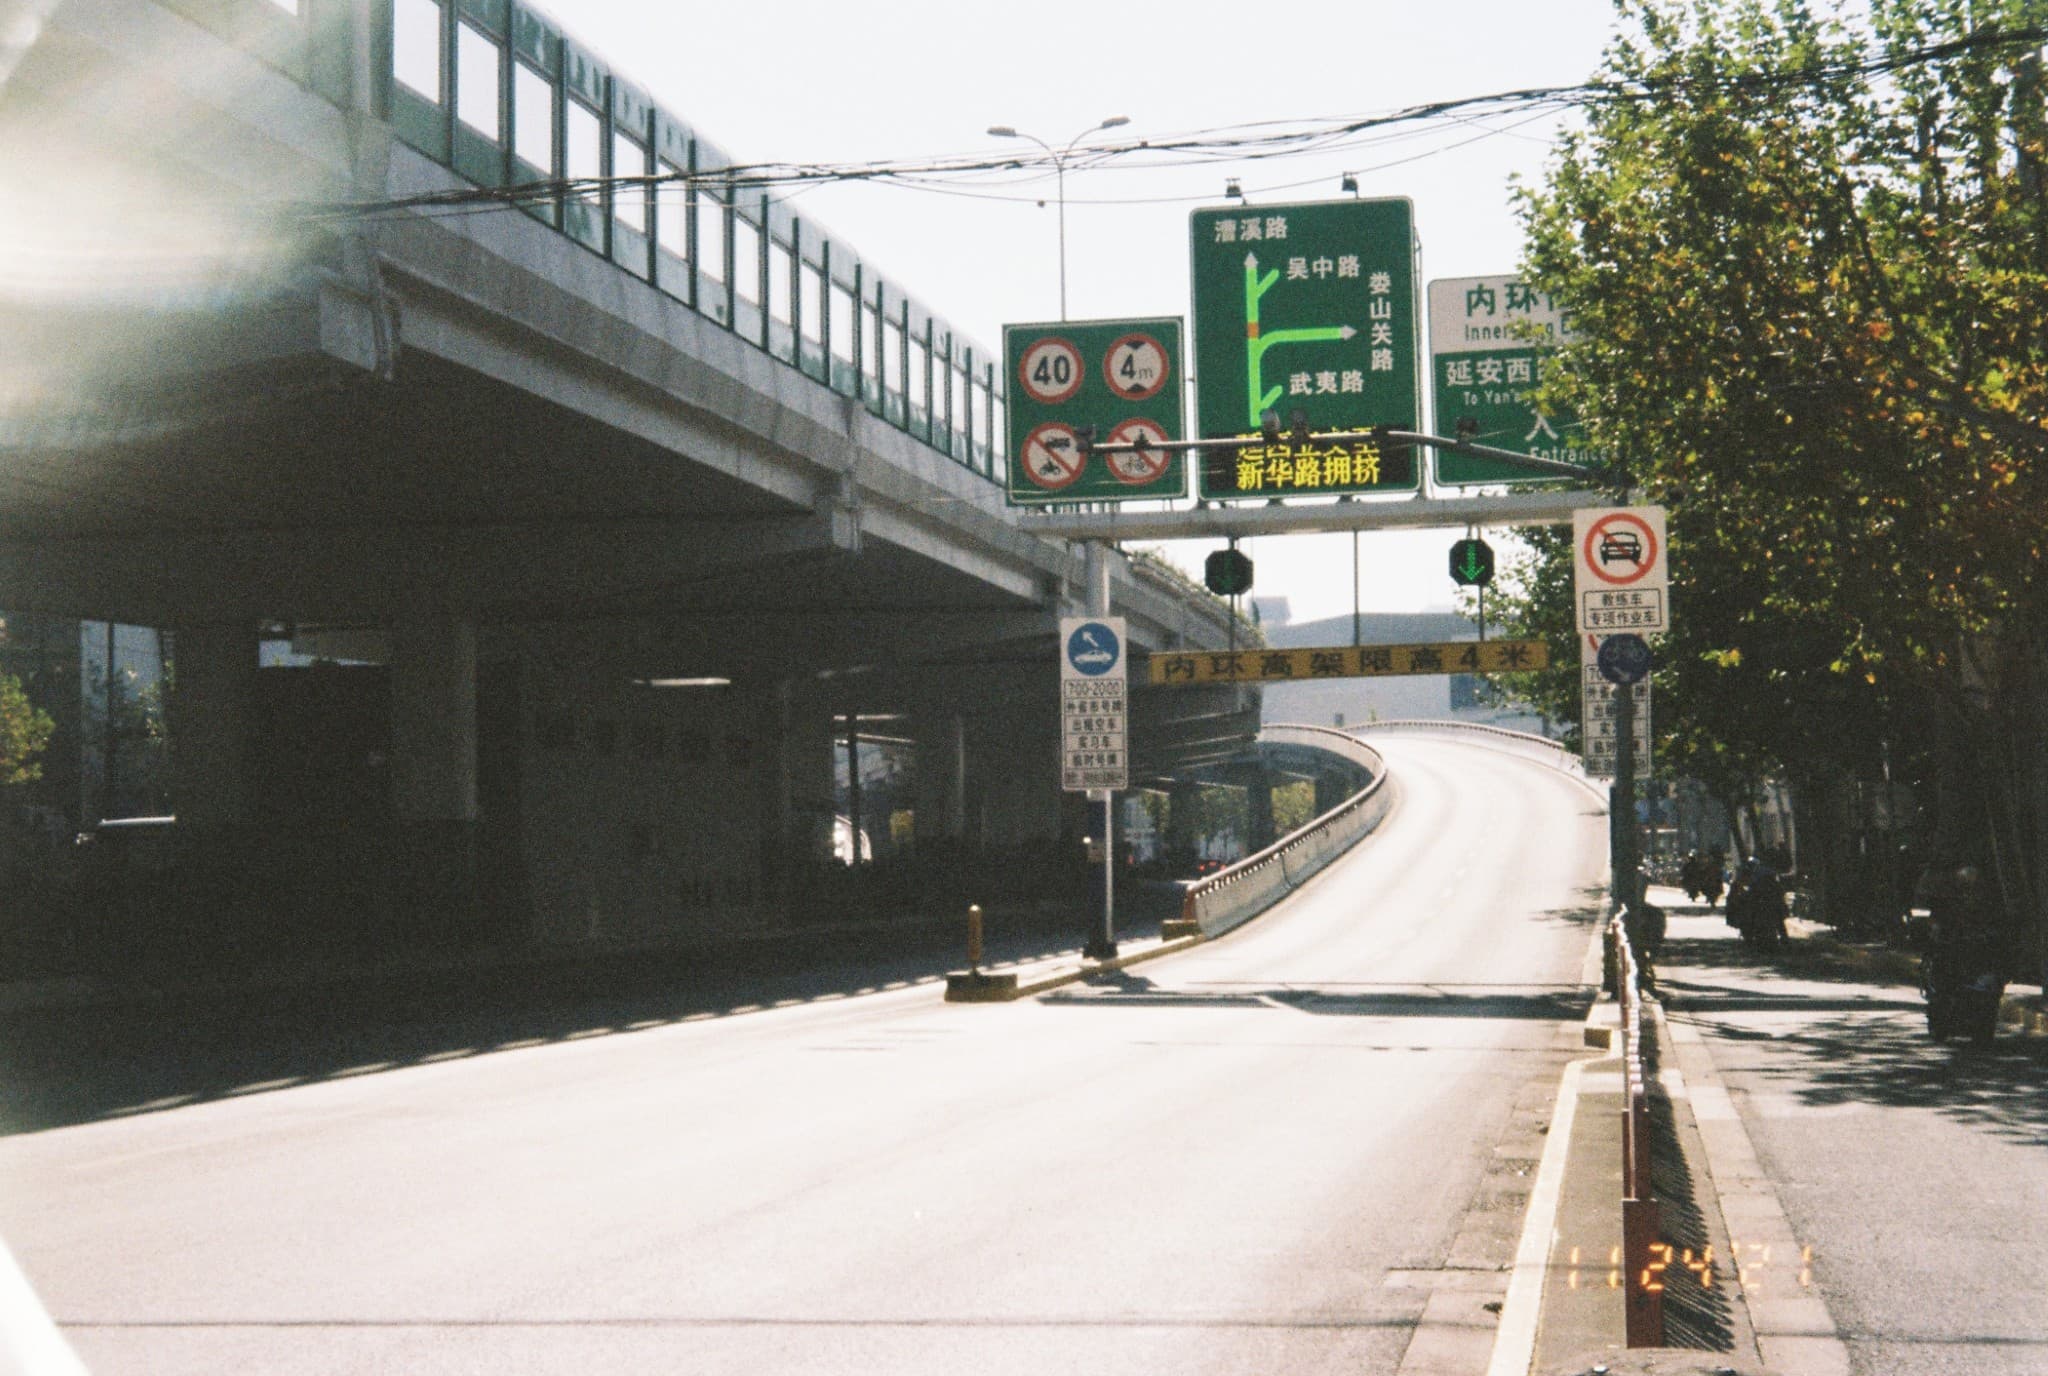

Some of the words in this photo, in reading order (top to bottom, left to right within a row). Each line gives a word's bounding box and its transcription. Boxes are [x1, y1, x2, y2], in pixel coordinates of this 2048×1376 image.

[1215, 216, 1287, 242] 漕溪路
[1288, 255, 1360, 280] 吴中路
[1369, 271, 1393, 371] 娄山关路
[1034, 355, 1070, 385] 40
[1121, 354, 1153, 379] 4m
[1446, 356, 1546, 386] 延安西
[1289, 370, 1364, 395] 武夷路
[1463, 391, 1478, 406] To
[1236, 454, 1380, 491] 新华路拥挤
[1163, 643, 1530, 681] 内环高架限高4米
